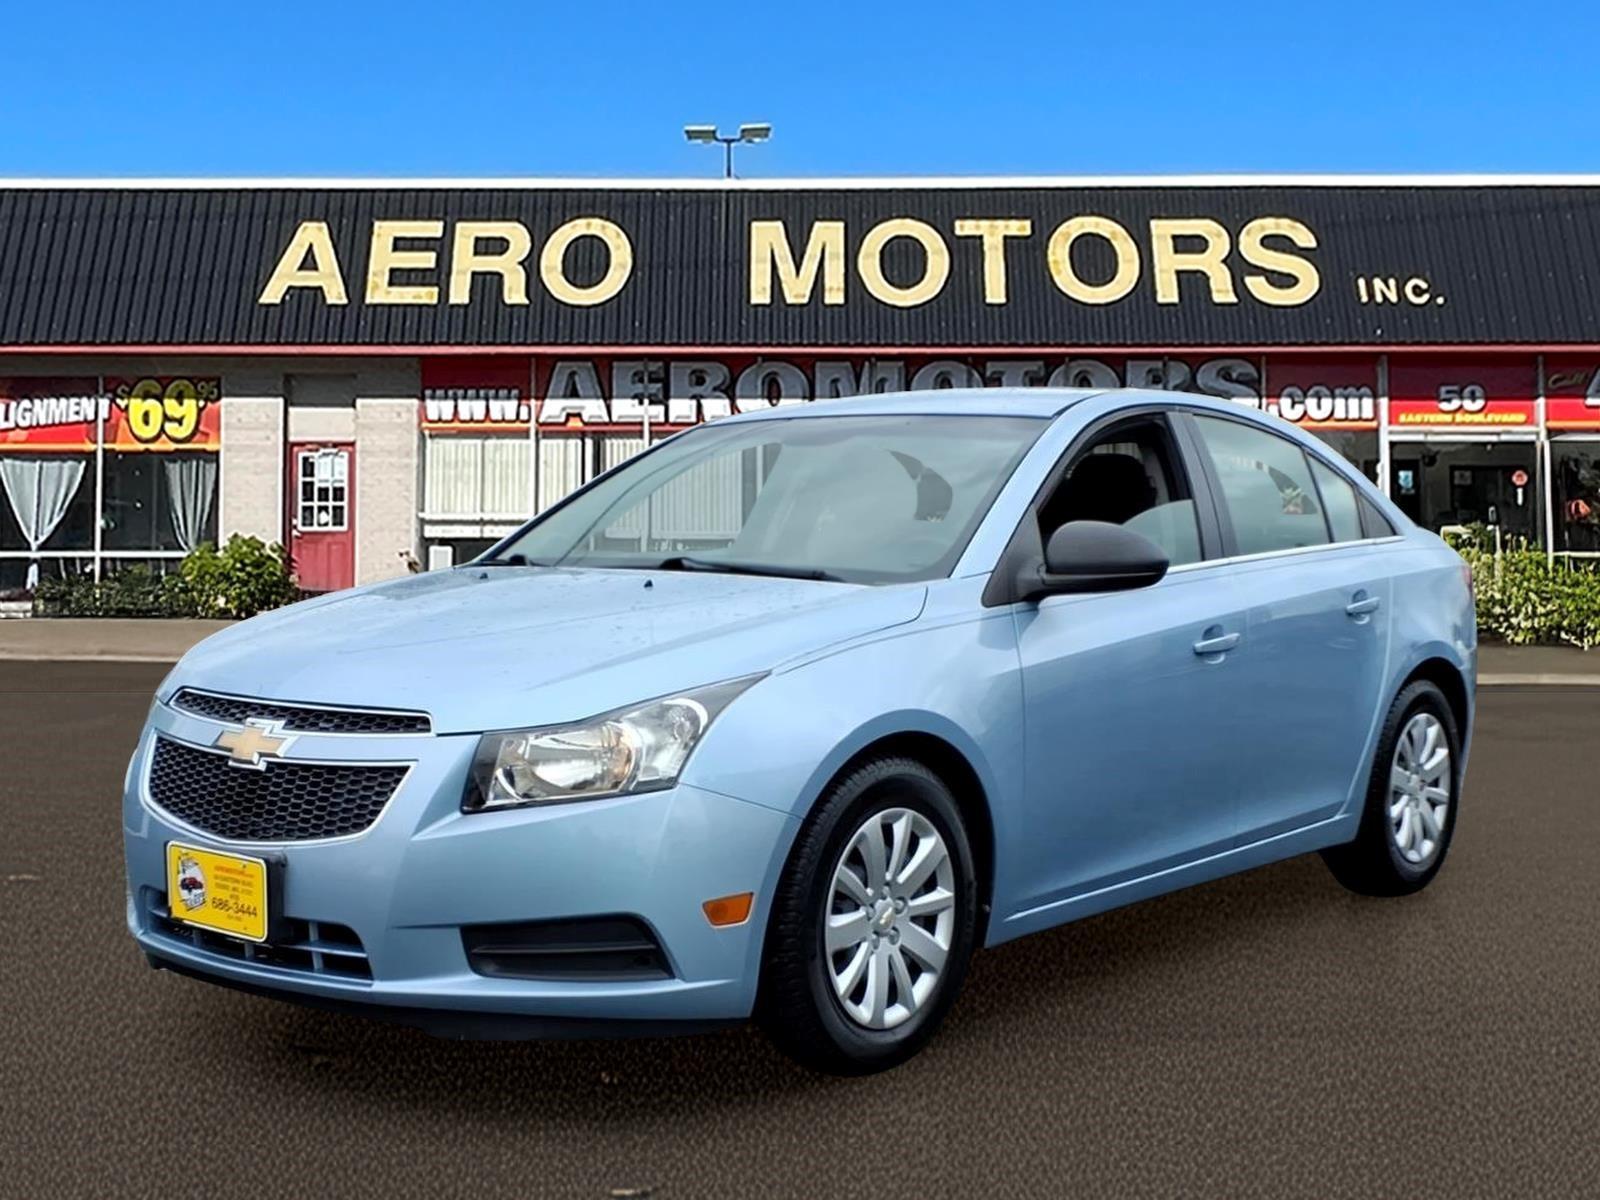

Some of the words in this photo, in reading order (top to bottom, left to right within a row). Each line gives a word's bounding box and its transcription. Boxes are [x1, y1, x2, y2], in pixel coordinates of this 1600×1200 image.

[259, 217, 634, 307] AERO
[749, 217, 1321, 307] MOTORS
[1357, 275, 1446, 306] INC.
[1438, 385, 1486, 412] 50
[1398, 412, 1453, 424] EASTERN
[1455, 411, 1528, 424] BOULEVARD
